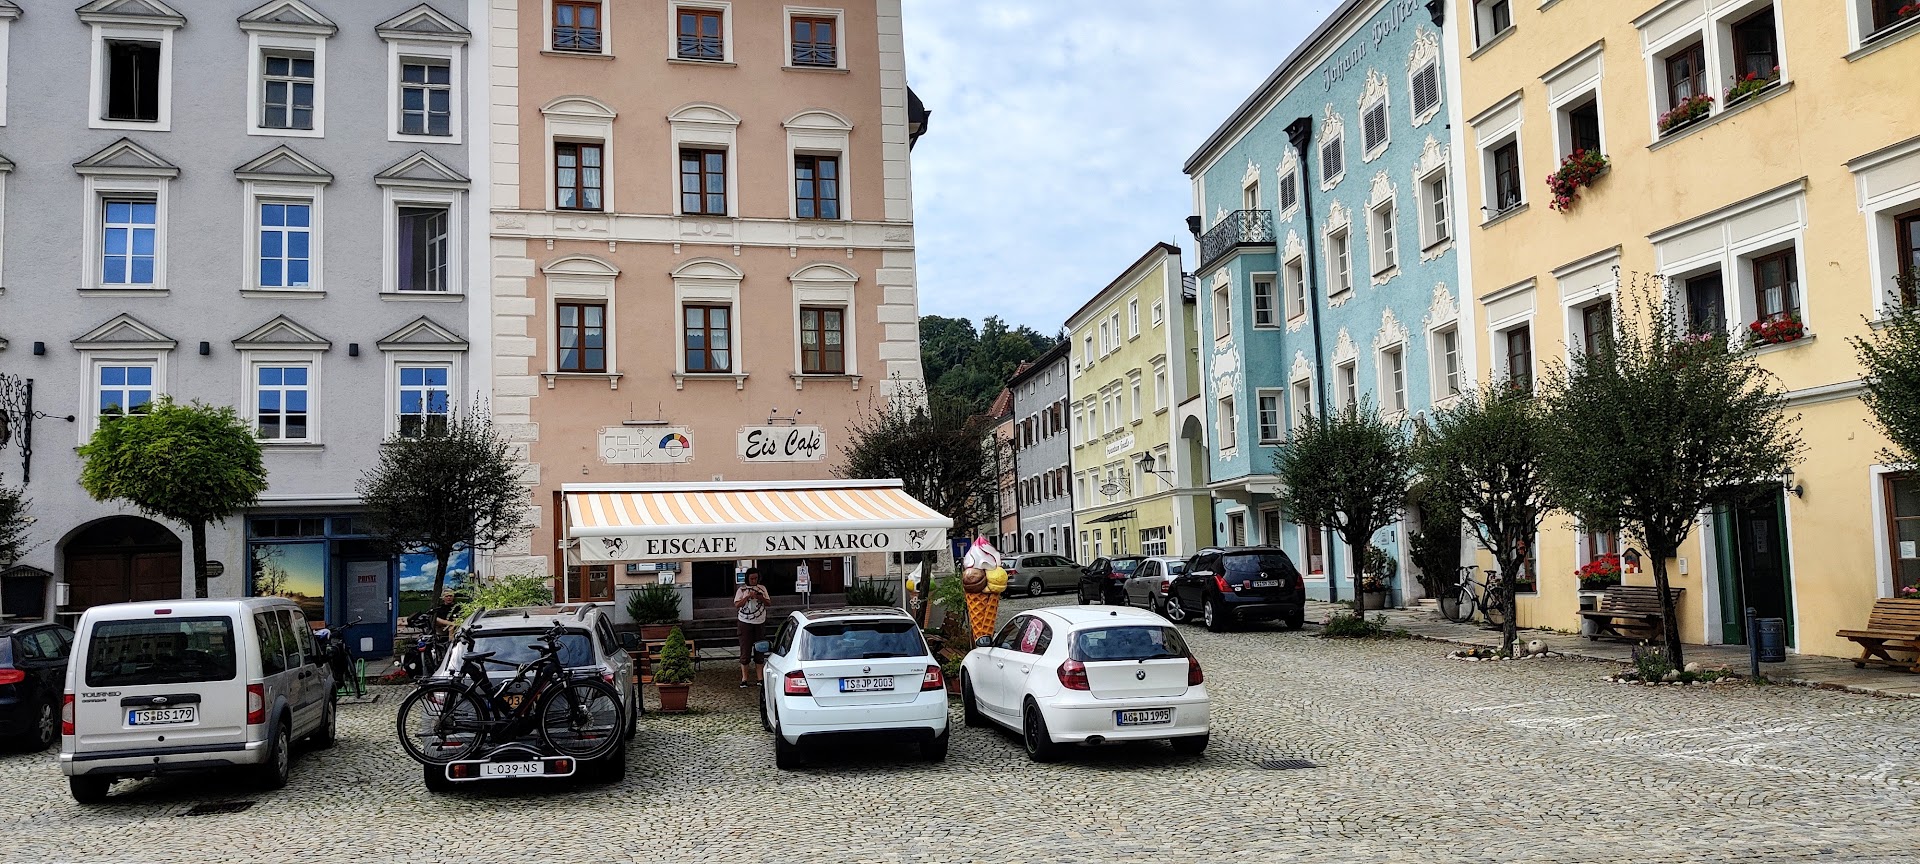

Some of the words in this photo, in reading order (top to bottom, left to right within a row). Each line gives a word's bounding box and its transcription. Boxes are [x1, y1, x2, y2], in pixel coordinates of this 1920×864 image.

[746, 429, 777, 459] Eis
[784, 429, 821, 458] Café
[646, 537, 737, 555] EISCAFE
[765, 535, 806, 551] SAN
[813, 532, 889, 550] MARCO
[873, 677, 893, 688] 2003
[172, 710, 192, 720] 179
[1150, 710, 1169, 721] 1995
